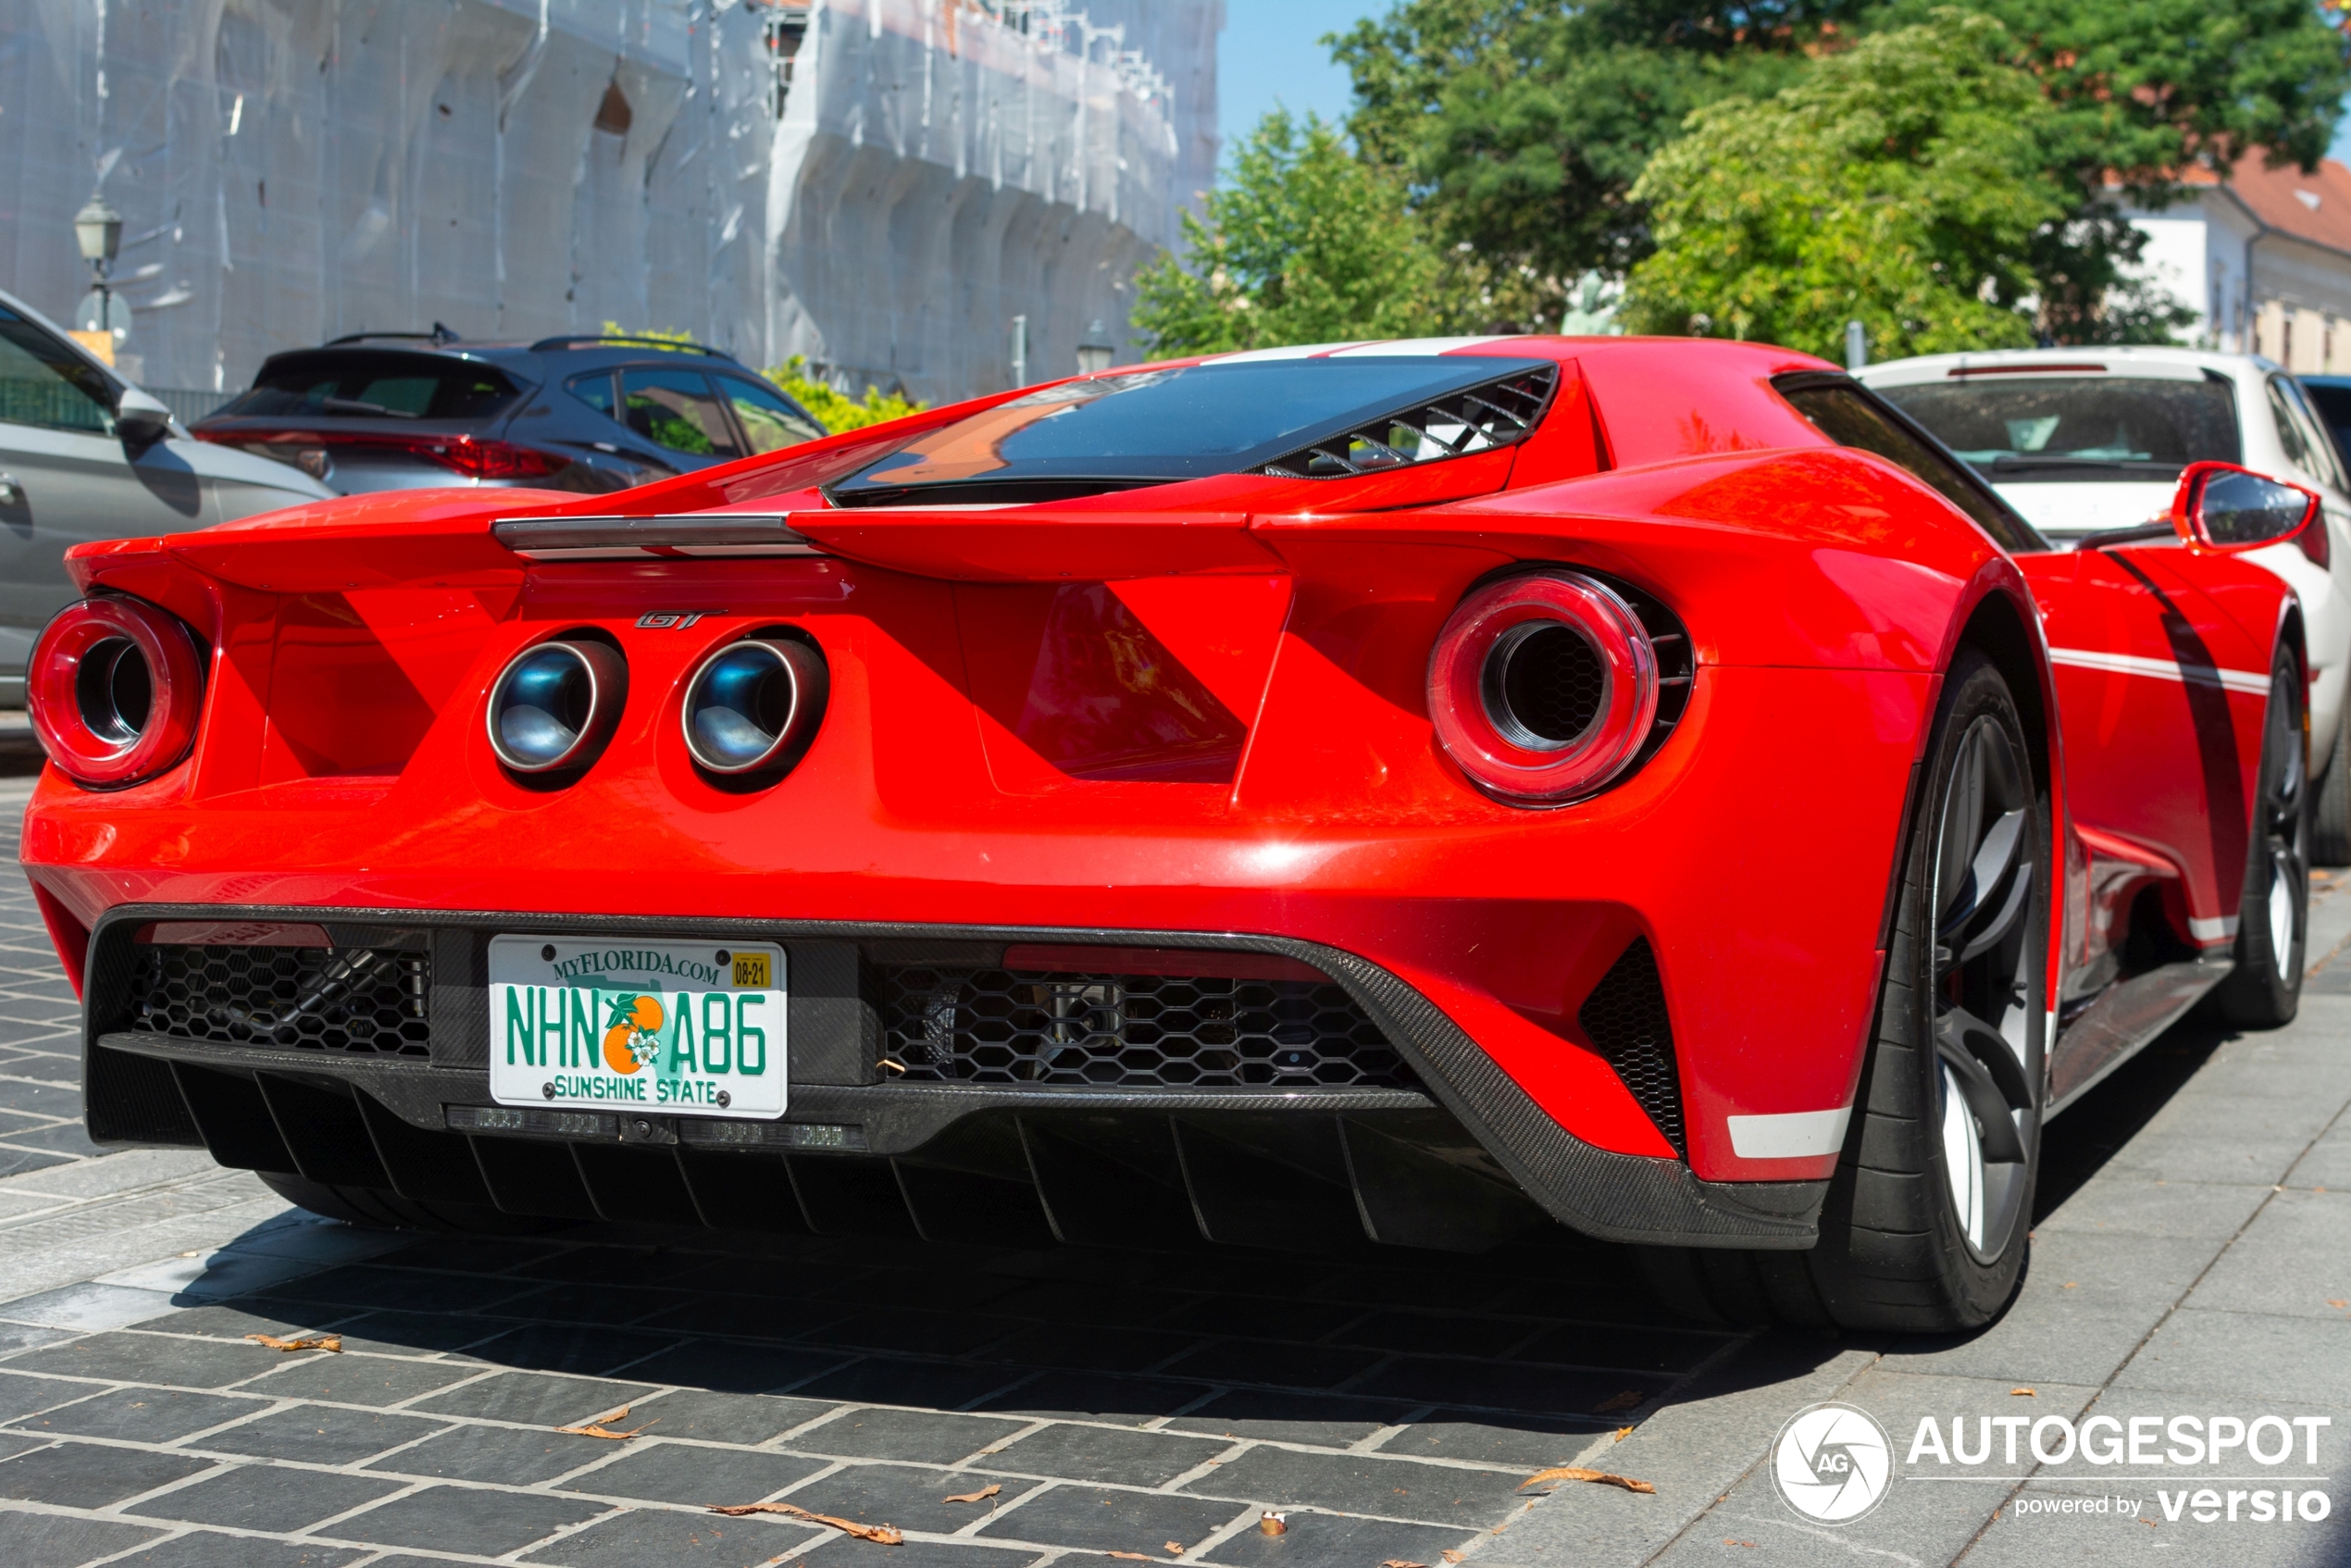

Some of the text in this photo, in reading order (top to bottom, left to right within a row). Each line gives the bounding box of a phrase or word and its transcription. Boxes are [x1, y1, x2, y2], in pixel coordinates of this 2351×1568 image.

[634, 610, 728, 630] GT
[553, 950, 720, 987] MYFLORIDA.COM
[735, 962, 764, 985] 08-21
[506, 986, 766, 1075] NHN A86
[554, 1075, 717, 1103] SUNSHINE STATE
